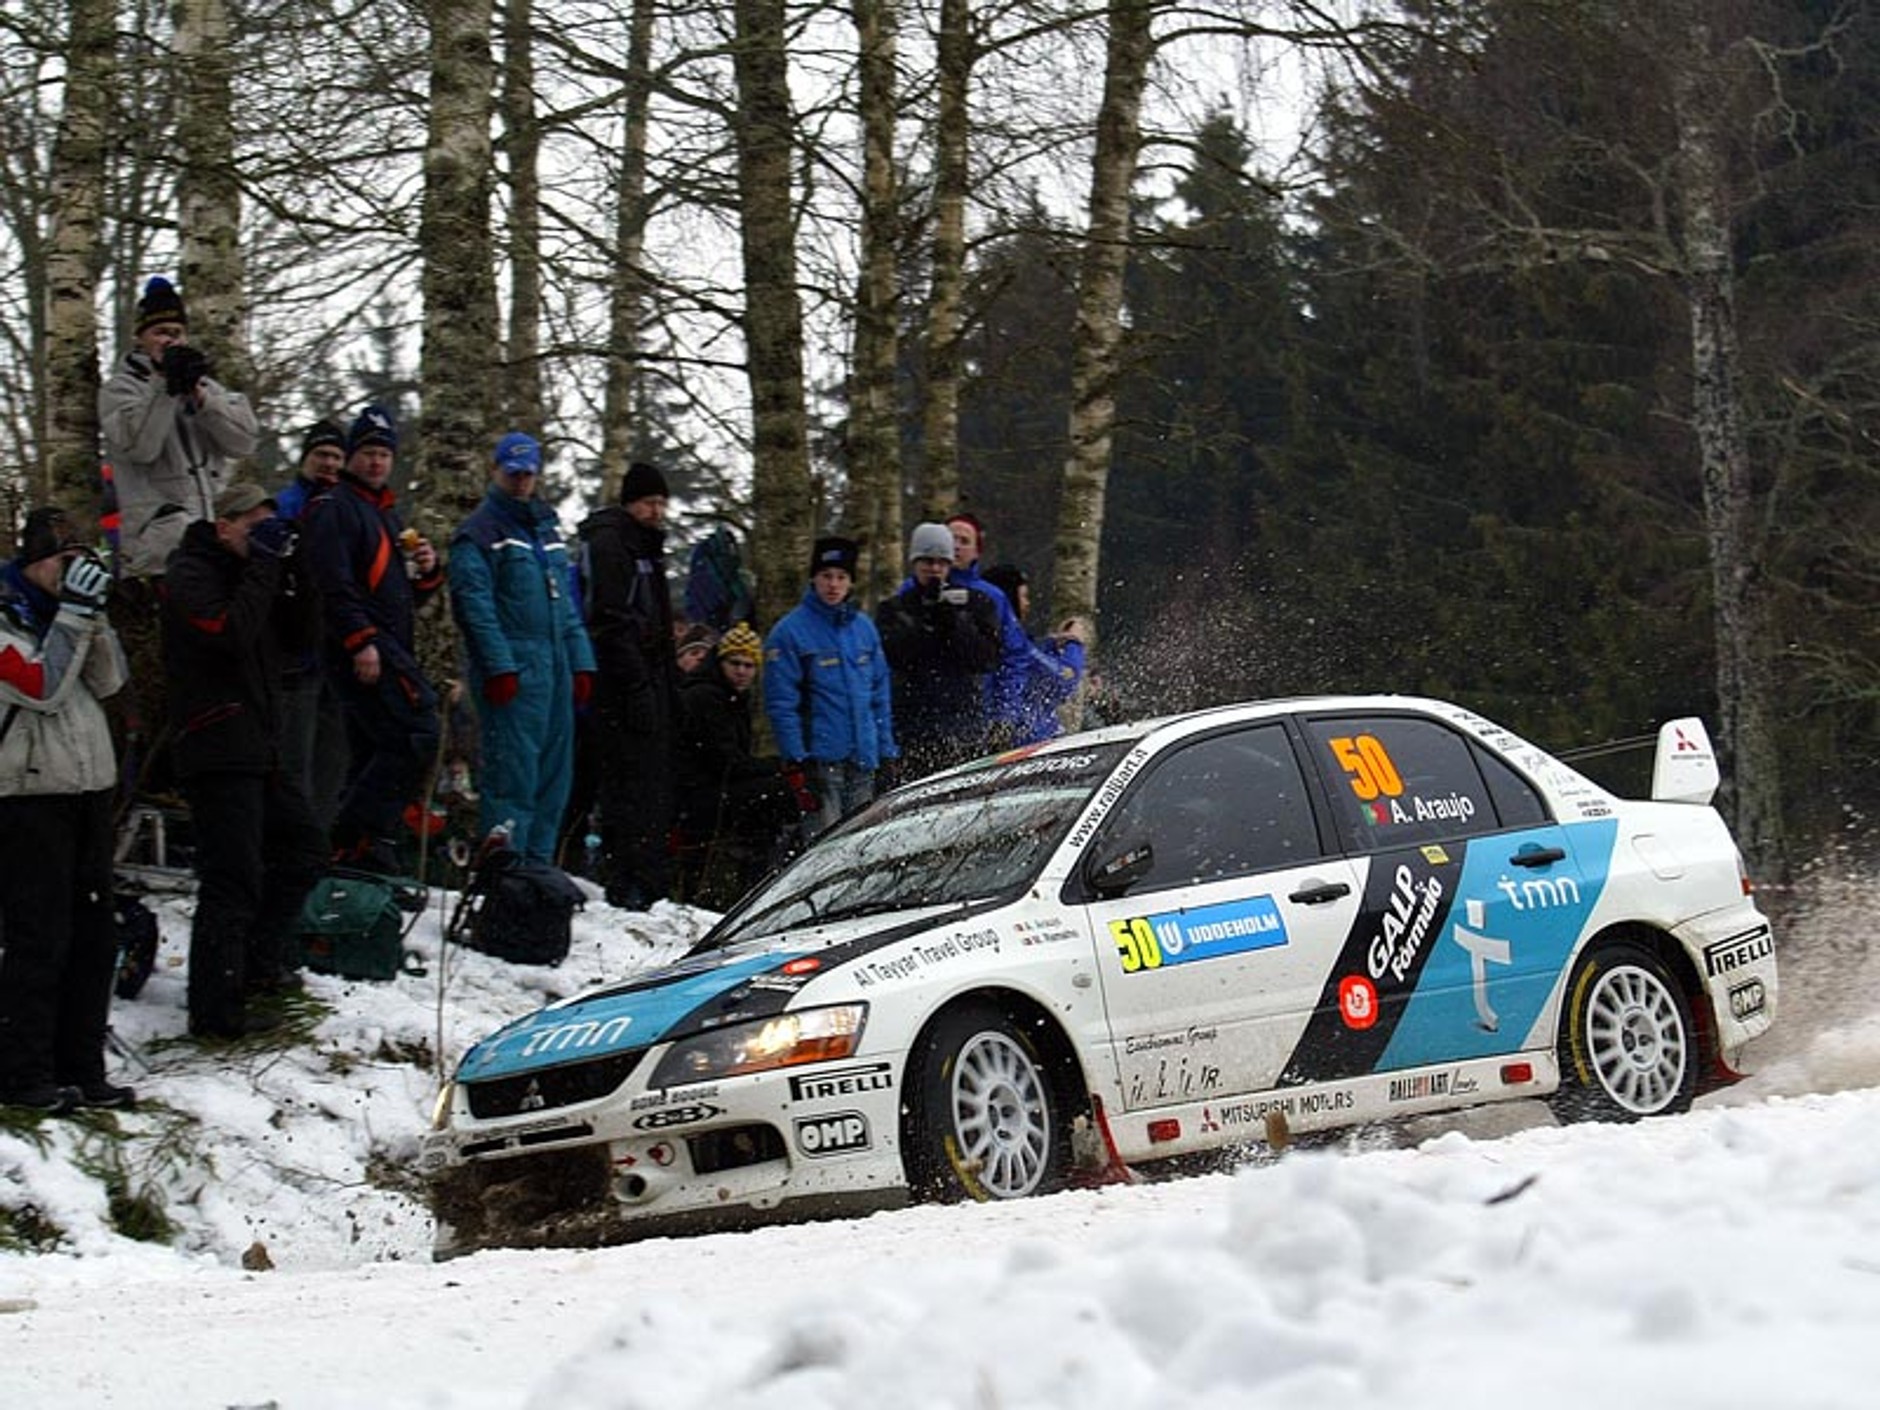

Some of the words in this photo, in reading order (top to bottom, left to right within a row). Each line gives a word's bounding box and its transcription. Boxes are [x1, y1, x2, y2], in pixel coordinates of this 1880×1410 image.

[1329, 734, 1404, 800] 50
[1390, 798, 1413, 824] A.
[1414, 792, 1475, 823] Araujo
[1497, 874, 1580, 911] tmn
[1367, 864, 1413, 980] GALP
[913, 938, 958, 964] Travel
[955, 927, 1000, 953] Group
[1107, 917, 1162, 972] 50
[1187, 913, 1280, 944] UDDEHOLM
[1703, 923, 1773, 978] PIRELLI
[522, 1016, 632, 1057] tmn
[787, 1062, 892, 1101] PIRELLI
[800, 1117, 865, 1151] OMP
